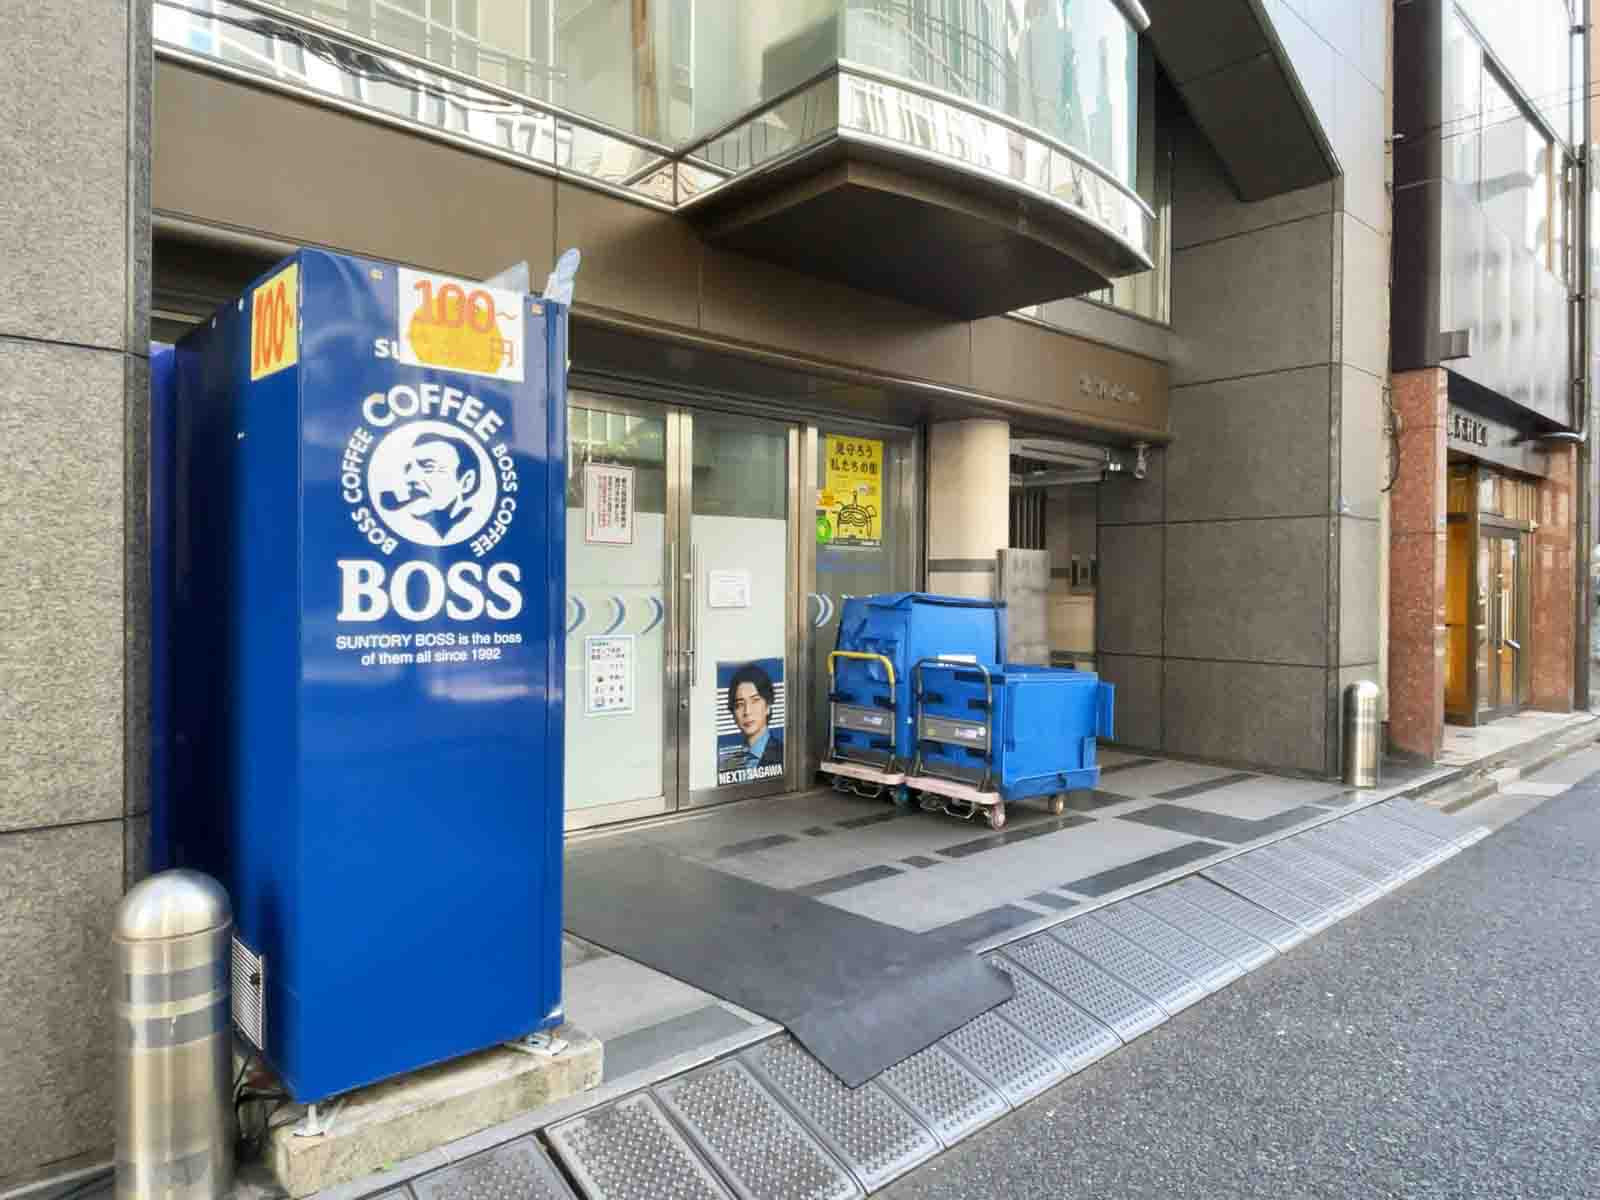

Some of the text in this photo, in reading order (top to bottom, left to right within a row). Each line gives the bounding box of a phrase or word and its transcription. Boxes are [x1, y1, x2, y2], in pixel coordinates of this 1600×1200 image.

[363, 384, 504, 441] COFFEE
[341, 427, 398, 555] BOSS COFFEE
[470, 443, 518, 557] BOSS COFFEE
[336, 559, 522, 622] BOSS
[336, 632, 522, 650] SUNTORY BOSS is the boss
[361, 647, 501, 666] of them all since 1992
[746, 764, 782, 779] SAGAWA
